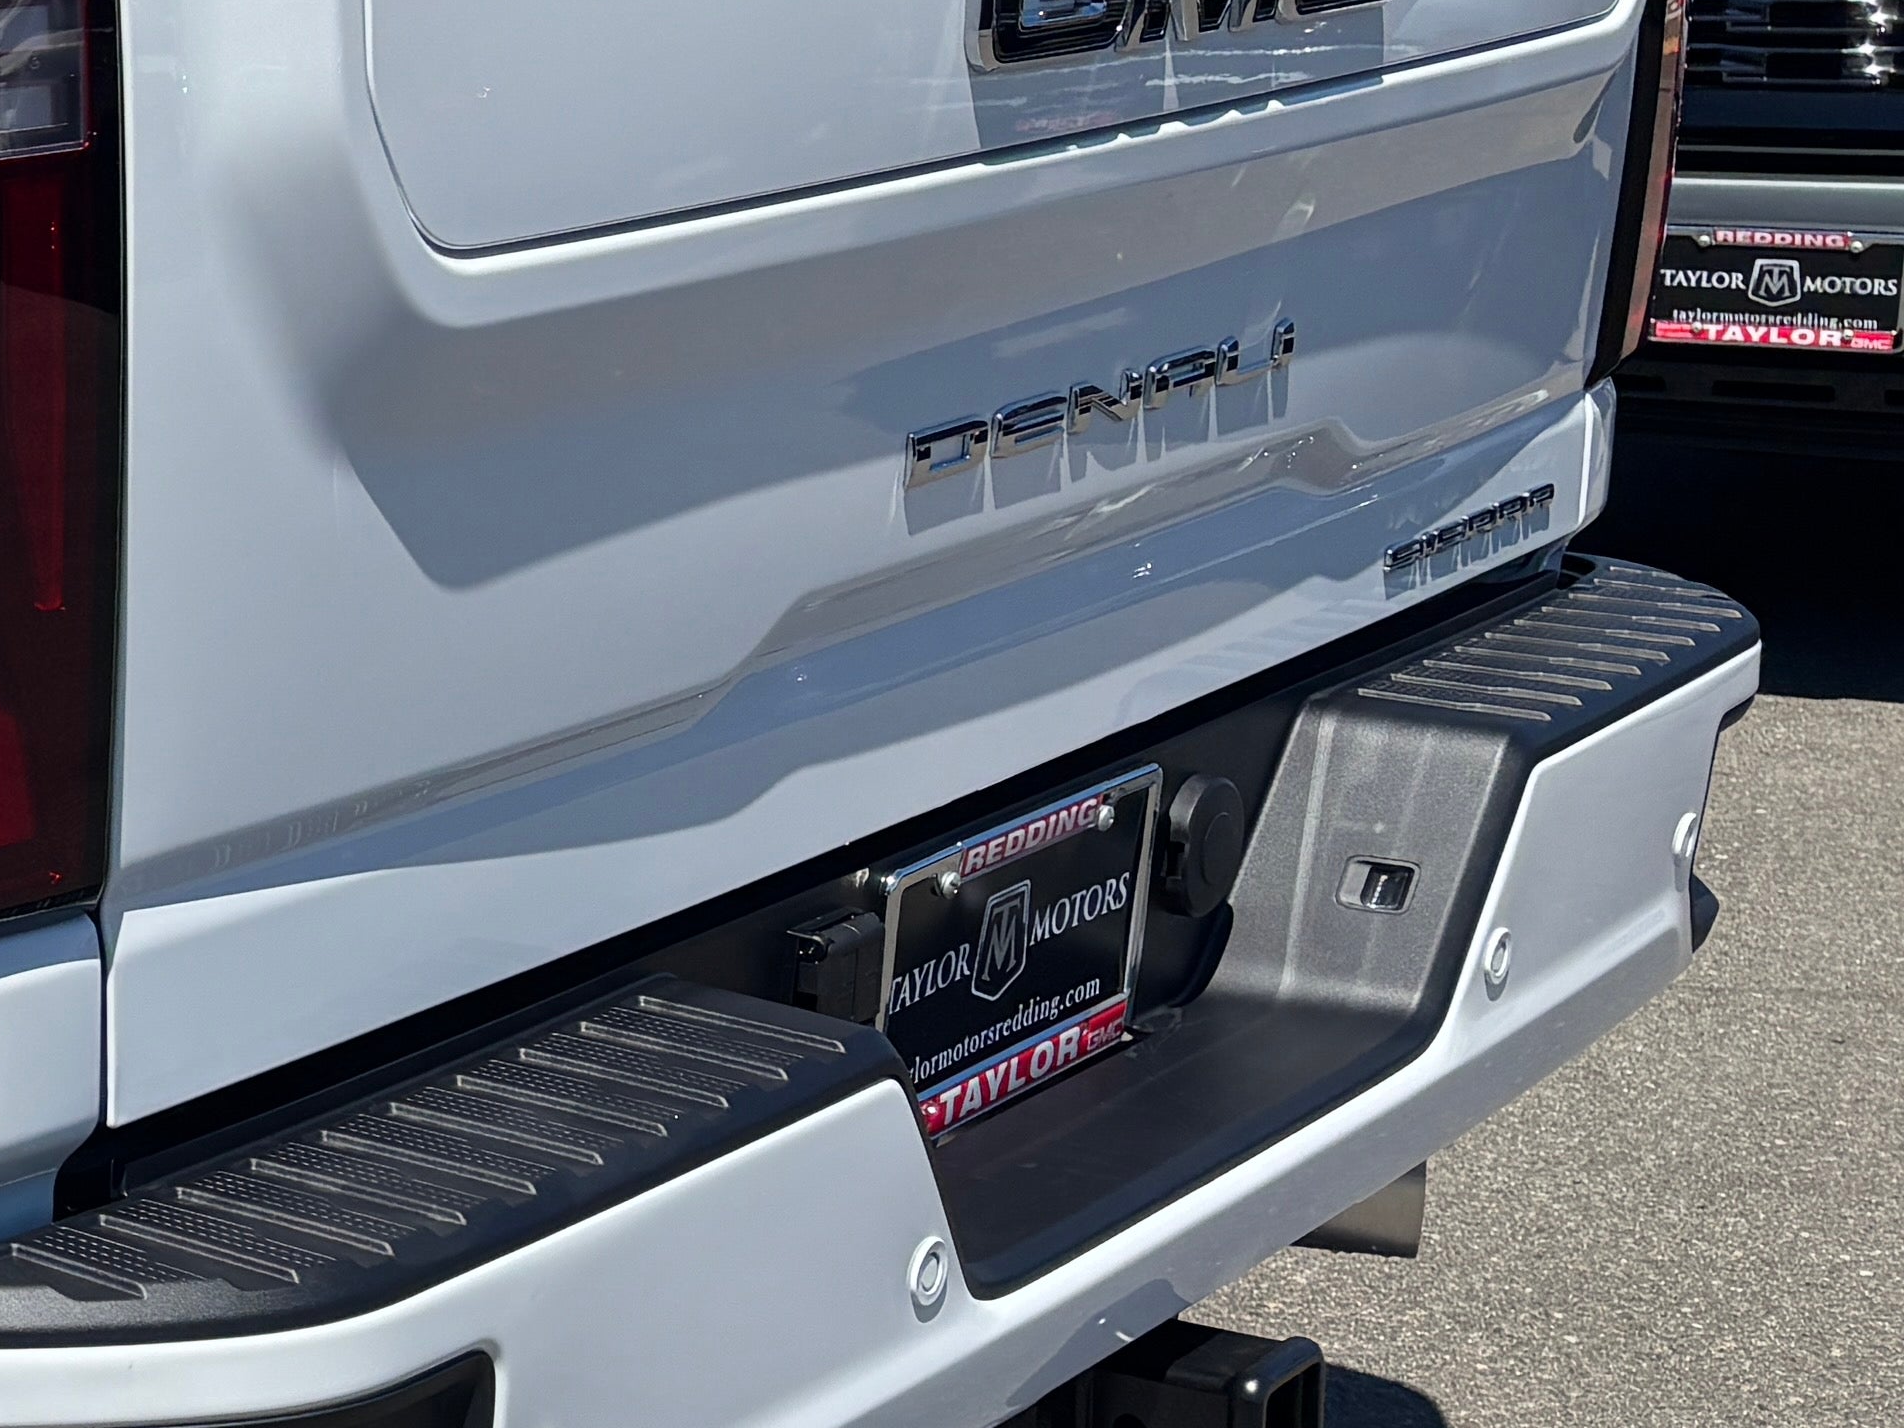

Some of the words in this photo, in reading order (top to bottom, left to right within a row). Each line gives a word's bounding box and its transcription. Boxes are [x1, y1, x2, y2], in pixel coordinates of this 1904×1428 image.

[1660, 268, 1747, 290] TAYLOR
[1803, 275, 1899, 297] MOTORS
[1715, 229, 1848, 248] REDDING
[1701, 324, 1842, 347] TAYLOR
[903, 317, 1295, 492] DENALI
[1382, 482, 1555, 573] SIERRA
[962, 797, 1099, 876] REDDING
[889, 942, 971, 1015] TAYLOR
[1029, 871, 1131, 947] MOTORS
[908, 977, 1100, 1085] lormotorsredding.com
[939, 1025, 1083, 1126] TAYLOR
[1087, 1017, 1125, 1052] GMC
